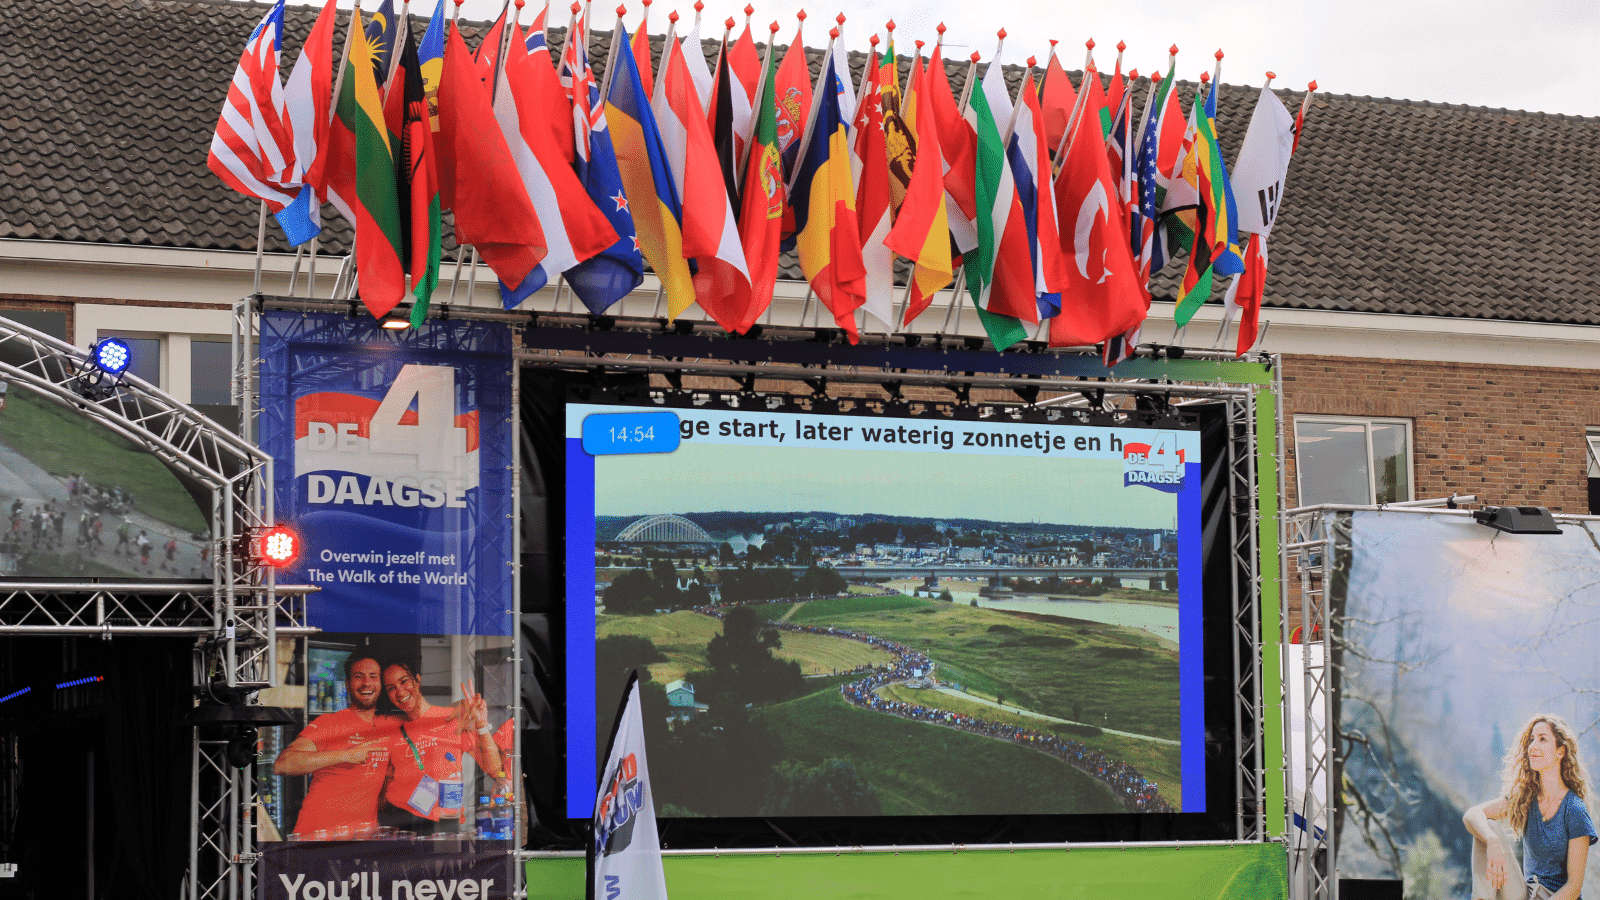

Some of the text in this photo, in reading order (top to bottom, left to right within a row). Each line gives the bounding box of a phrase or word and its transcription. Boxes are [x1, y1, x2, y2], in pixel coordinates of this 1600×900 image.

[308, 364, 467, 472] DE 4
[608, 425, 655, 443] 14:54
[680, 418, 1123, 454] ge start, later waterig zonnetje en h
[1128, 431, 1181, 472] DE 4
[308, 474, 467, 508] DAAGSE
[1128, 471, 1181, 484] DAAGSE
[320, 549, 456, 567] Overwin jezelf met
[308, 568, 468, 586] The Walk of the World
[278, 871, 494, 900] You'll never
